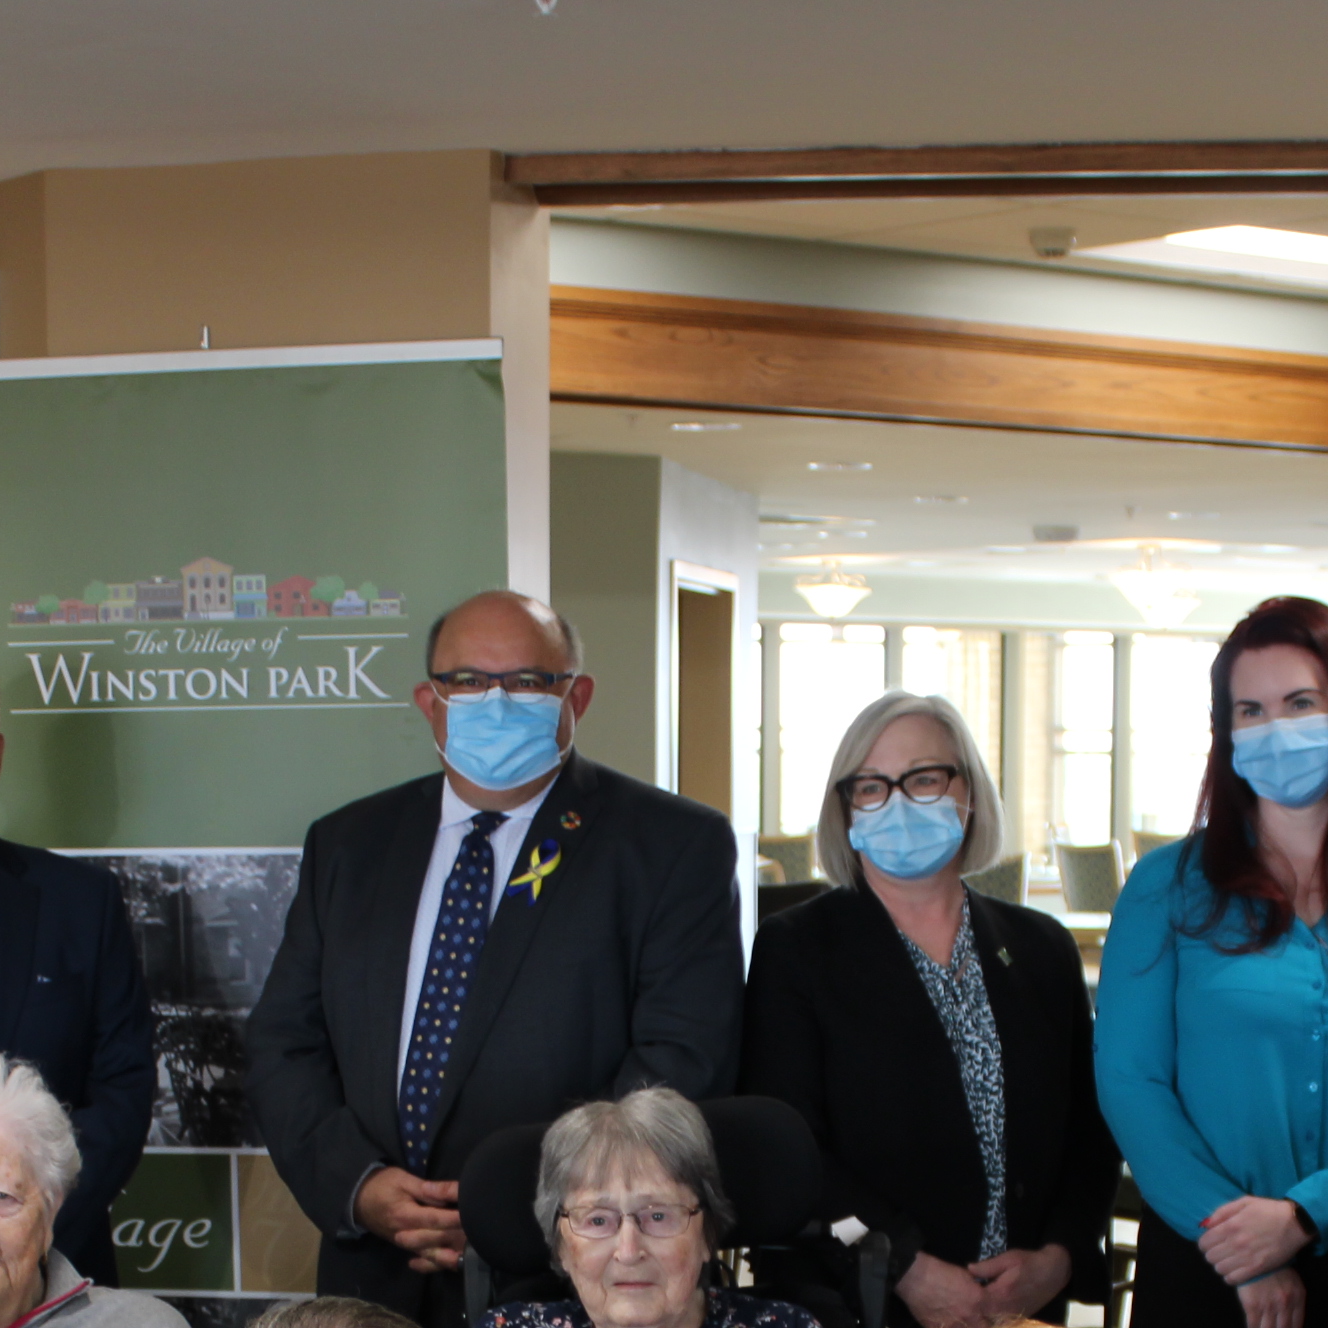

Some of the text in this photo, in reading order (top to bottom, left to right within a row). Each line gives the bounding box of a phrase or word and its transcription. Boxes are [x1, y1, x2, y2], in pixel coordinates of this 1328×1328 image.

[123, 626, 289, 662] The Village of
[24, 651, 250, 706] WINSTON
[111, 1215, 213, 1273] age
